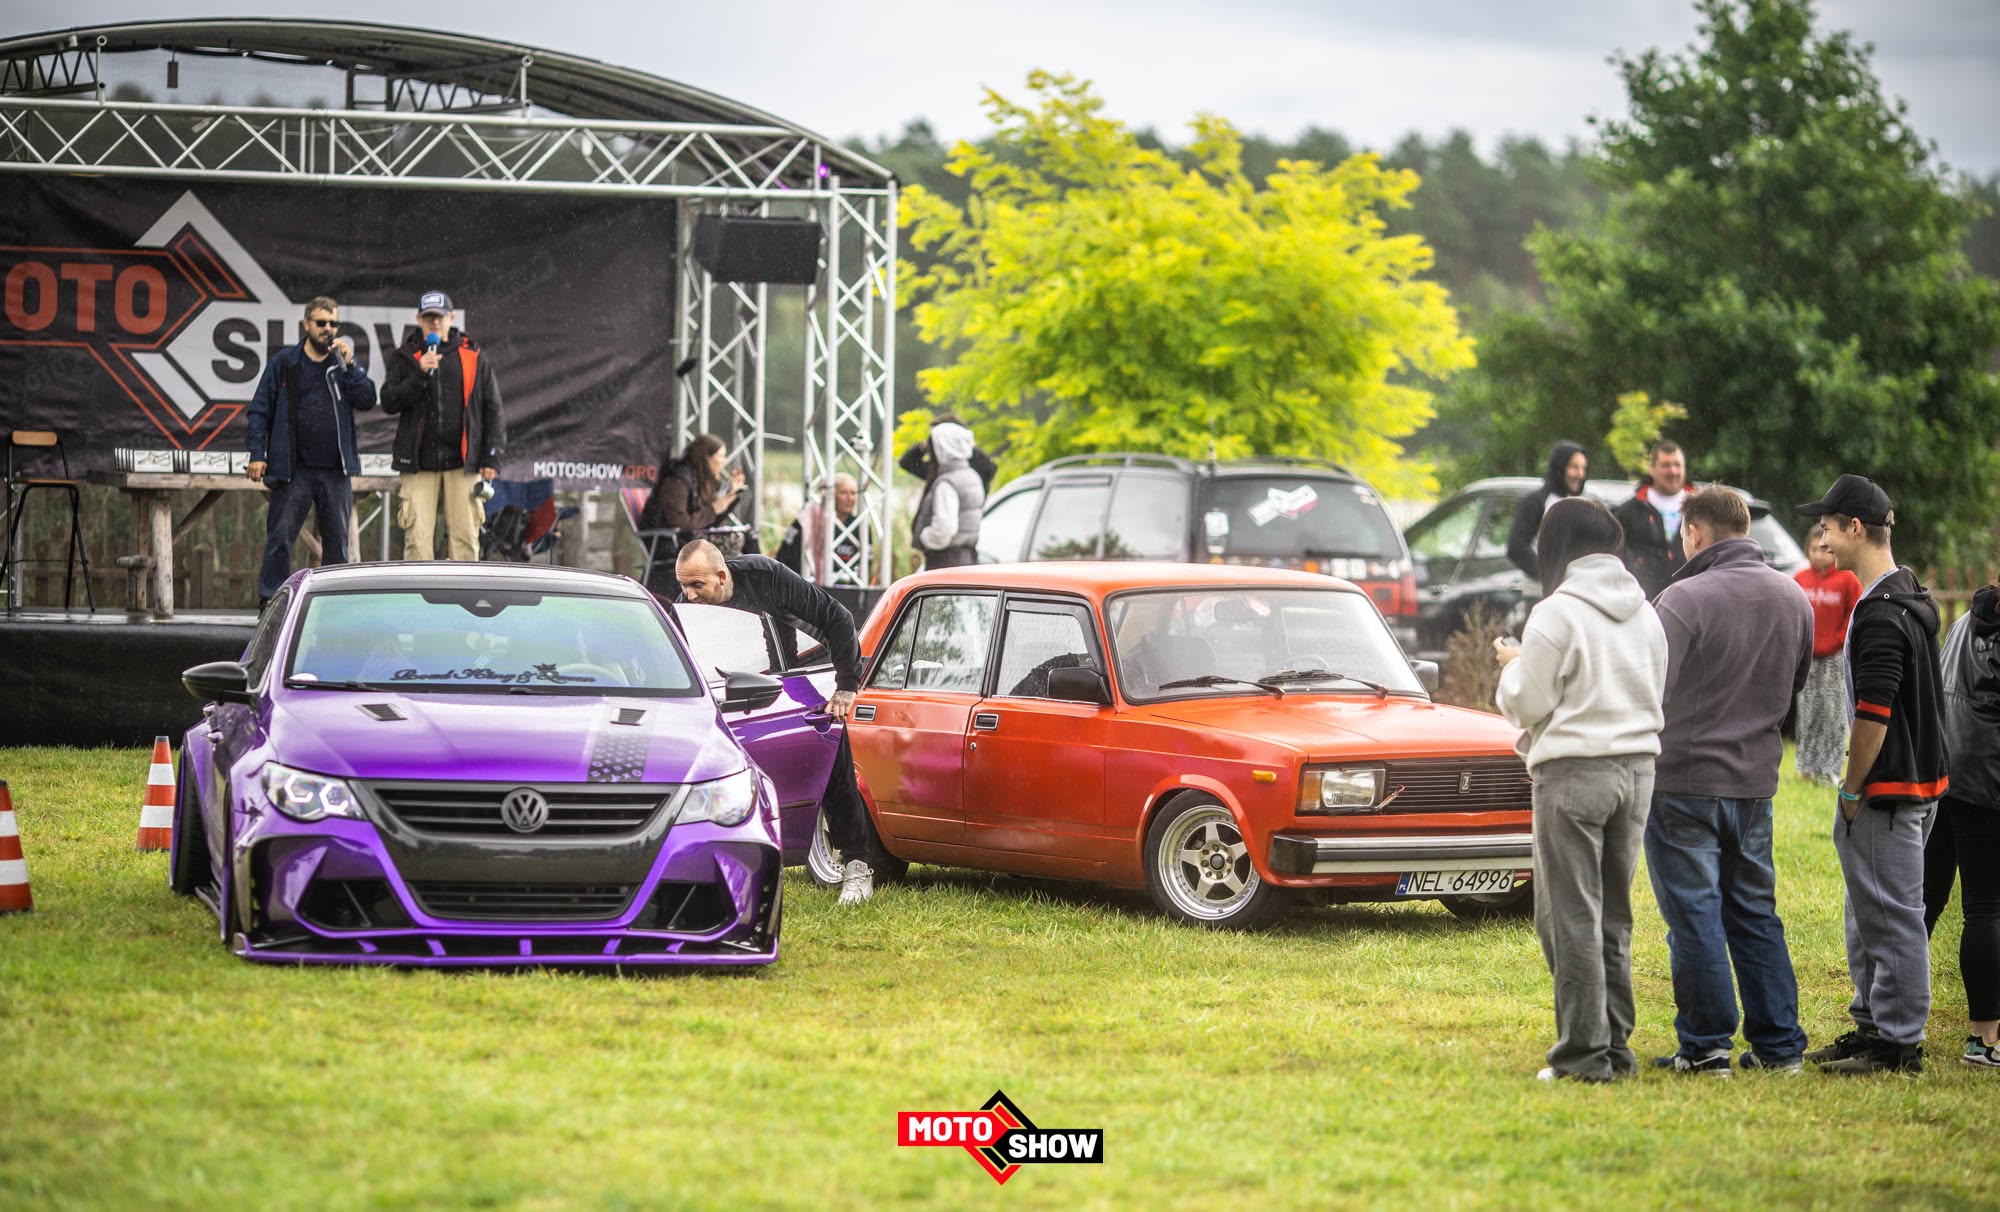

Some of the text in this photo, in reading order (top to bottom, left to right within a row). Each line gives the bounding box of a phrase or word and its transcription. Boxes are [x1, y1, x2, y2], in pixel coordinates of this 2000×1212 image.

[533, 461, 657, 481] MOTOSHOW.ORG
[504, 790, 544, 829] VW
[1408, 870, 1513, 892] NEL 64996
